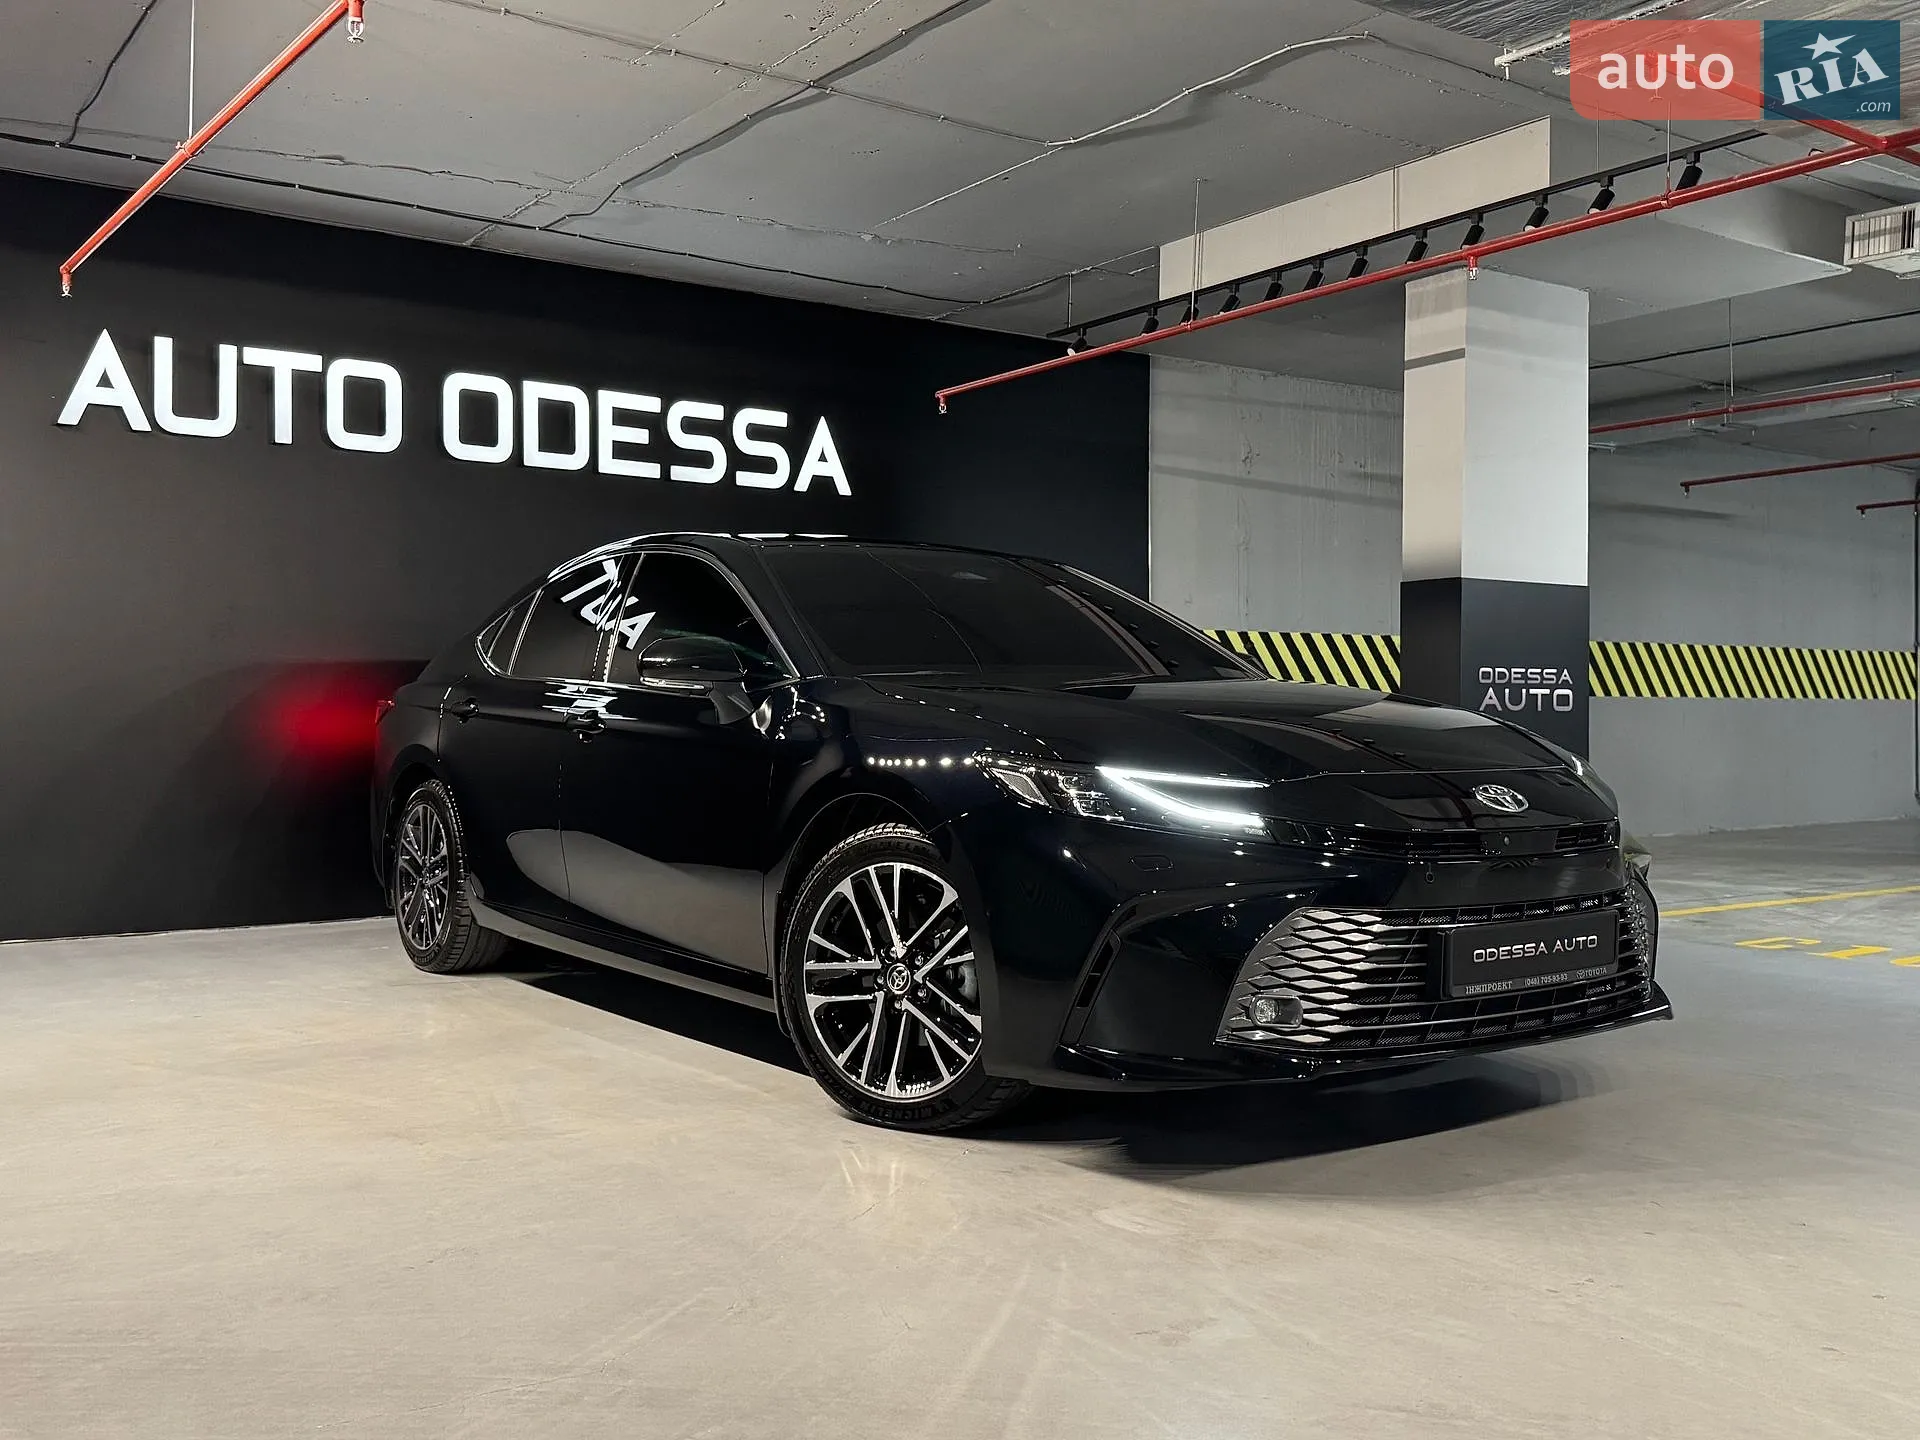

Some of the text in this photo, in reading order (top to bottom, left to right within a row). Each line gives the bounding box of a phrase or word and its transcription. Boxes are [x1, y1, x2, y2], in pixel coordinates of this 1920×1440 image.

[56, 328, 852, 496] AUTO ODESSA
[1479, 667, 1573, 684] ODESSA
[1479, 686, 1573, 712] AUTO
[1473, 935, 1598, 963] ODESSA AUTO
